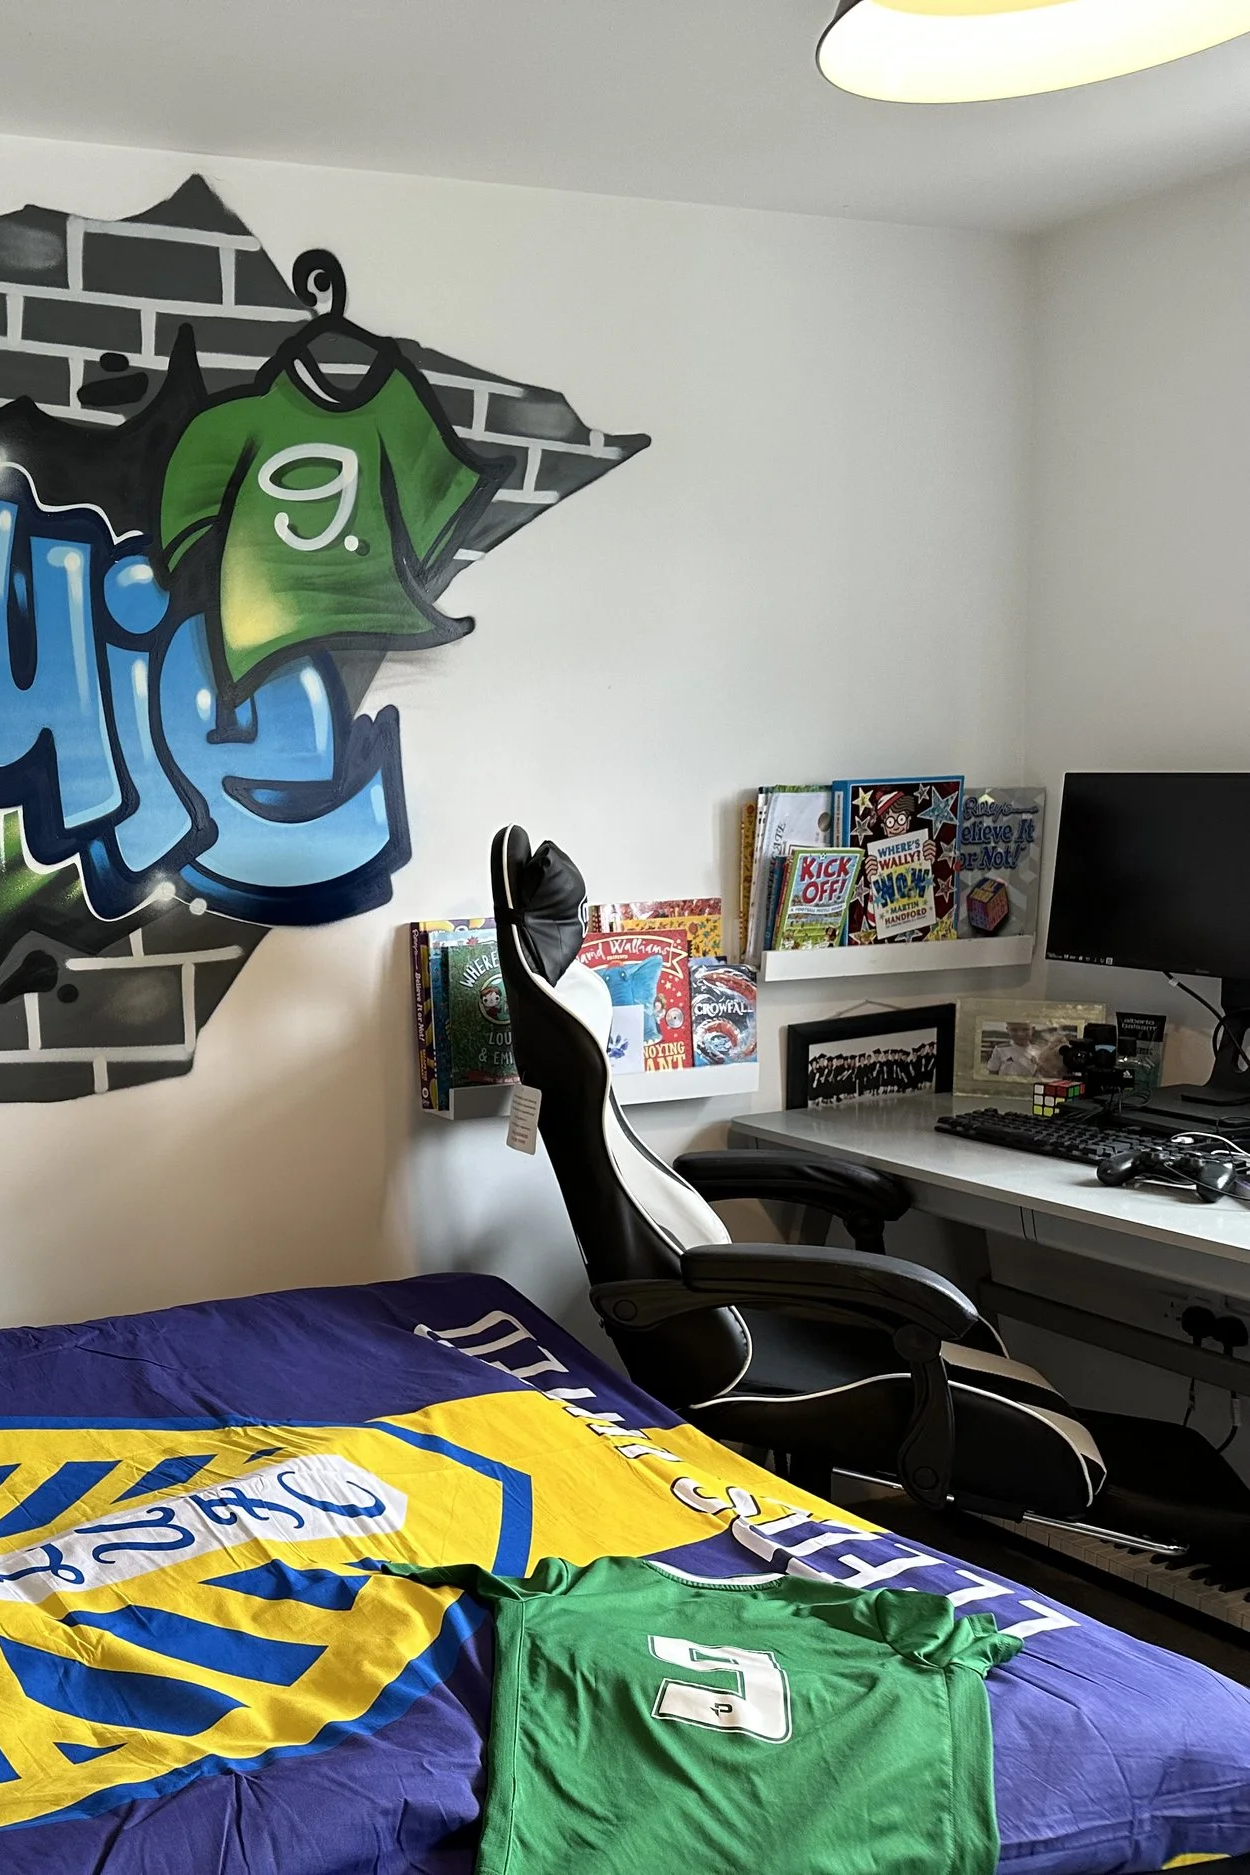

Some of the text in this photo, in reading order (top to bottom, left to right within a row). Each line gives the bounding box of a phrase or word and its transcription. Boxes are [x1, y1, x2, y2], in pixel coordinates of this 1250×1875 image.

[1016, 818, 1035, 843] It
[877, 838, 921, 858] WHERE'S
[979, 844, 1022, 870] Not!
[878, 850, 921, 871] WALLY?
[802, 877, 846, 905] OFF!
[873, 867, 930, 908] WOW
[885, 907, 927, 926] HANDFORD
[890, 901, 919, 915] MARTIN
[609, 938, 670, 955] Walliams
[478, 1047, 488, 1063] &
